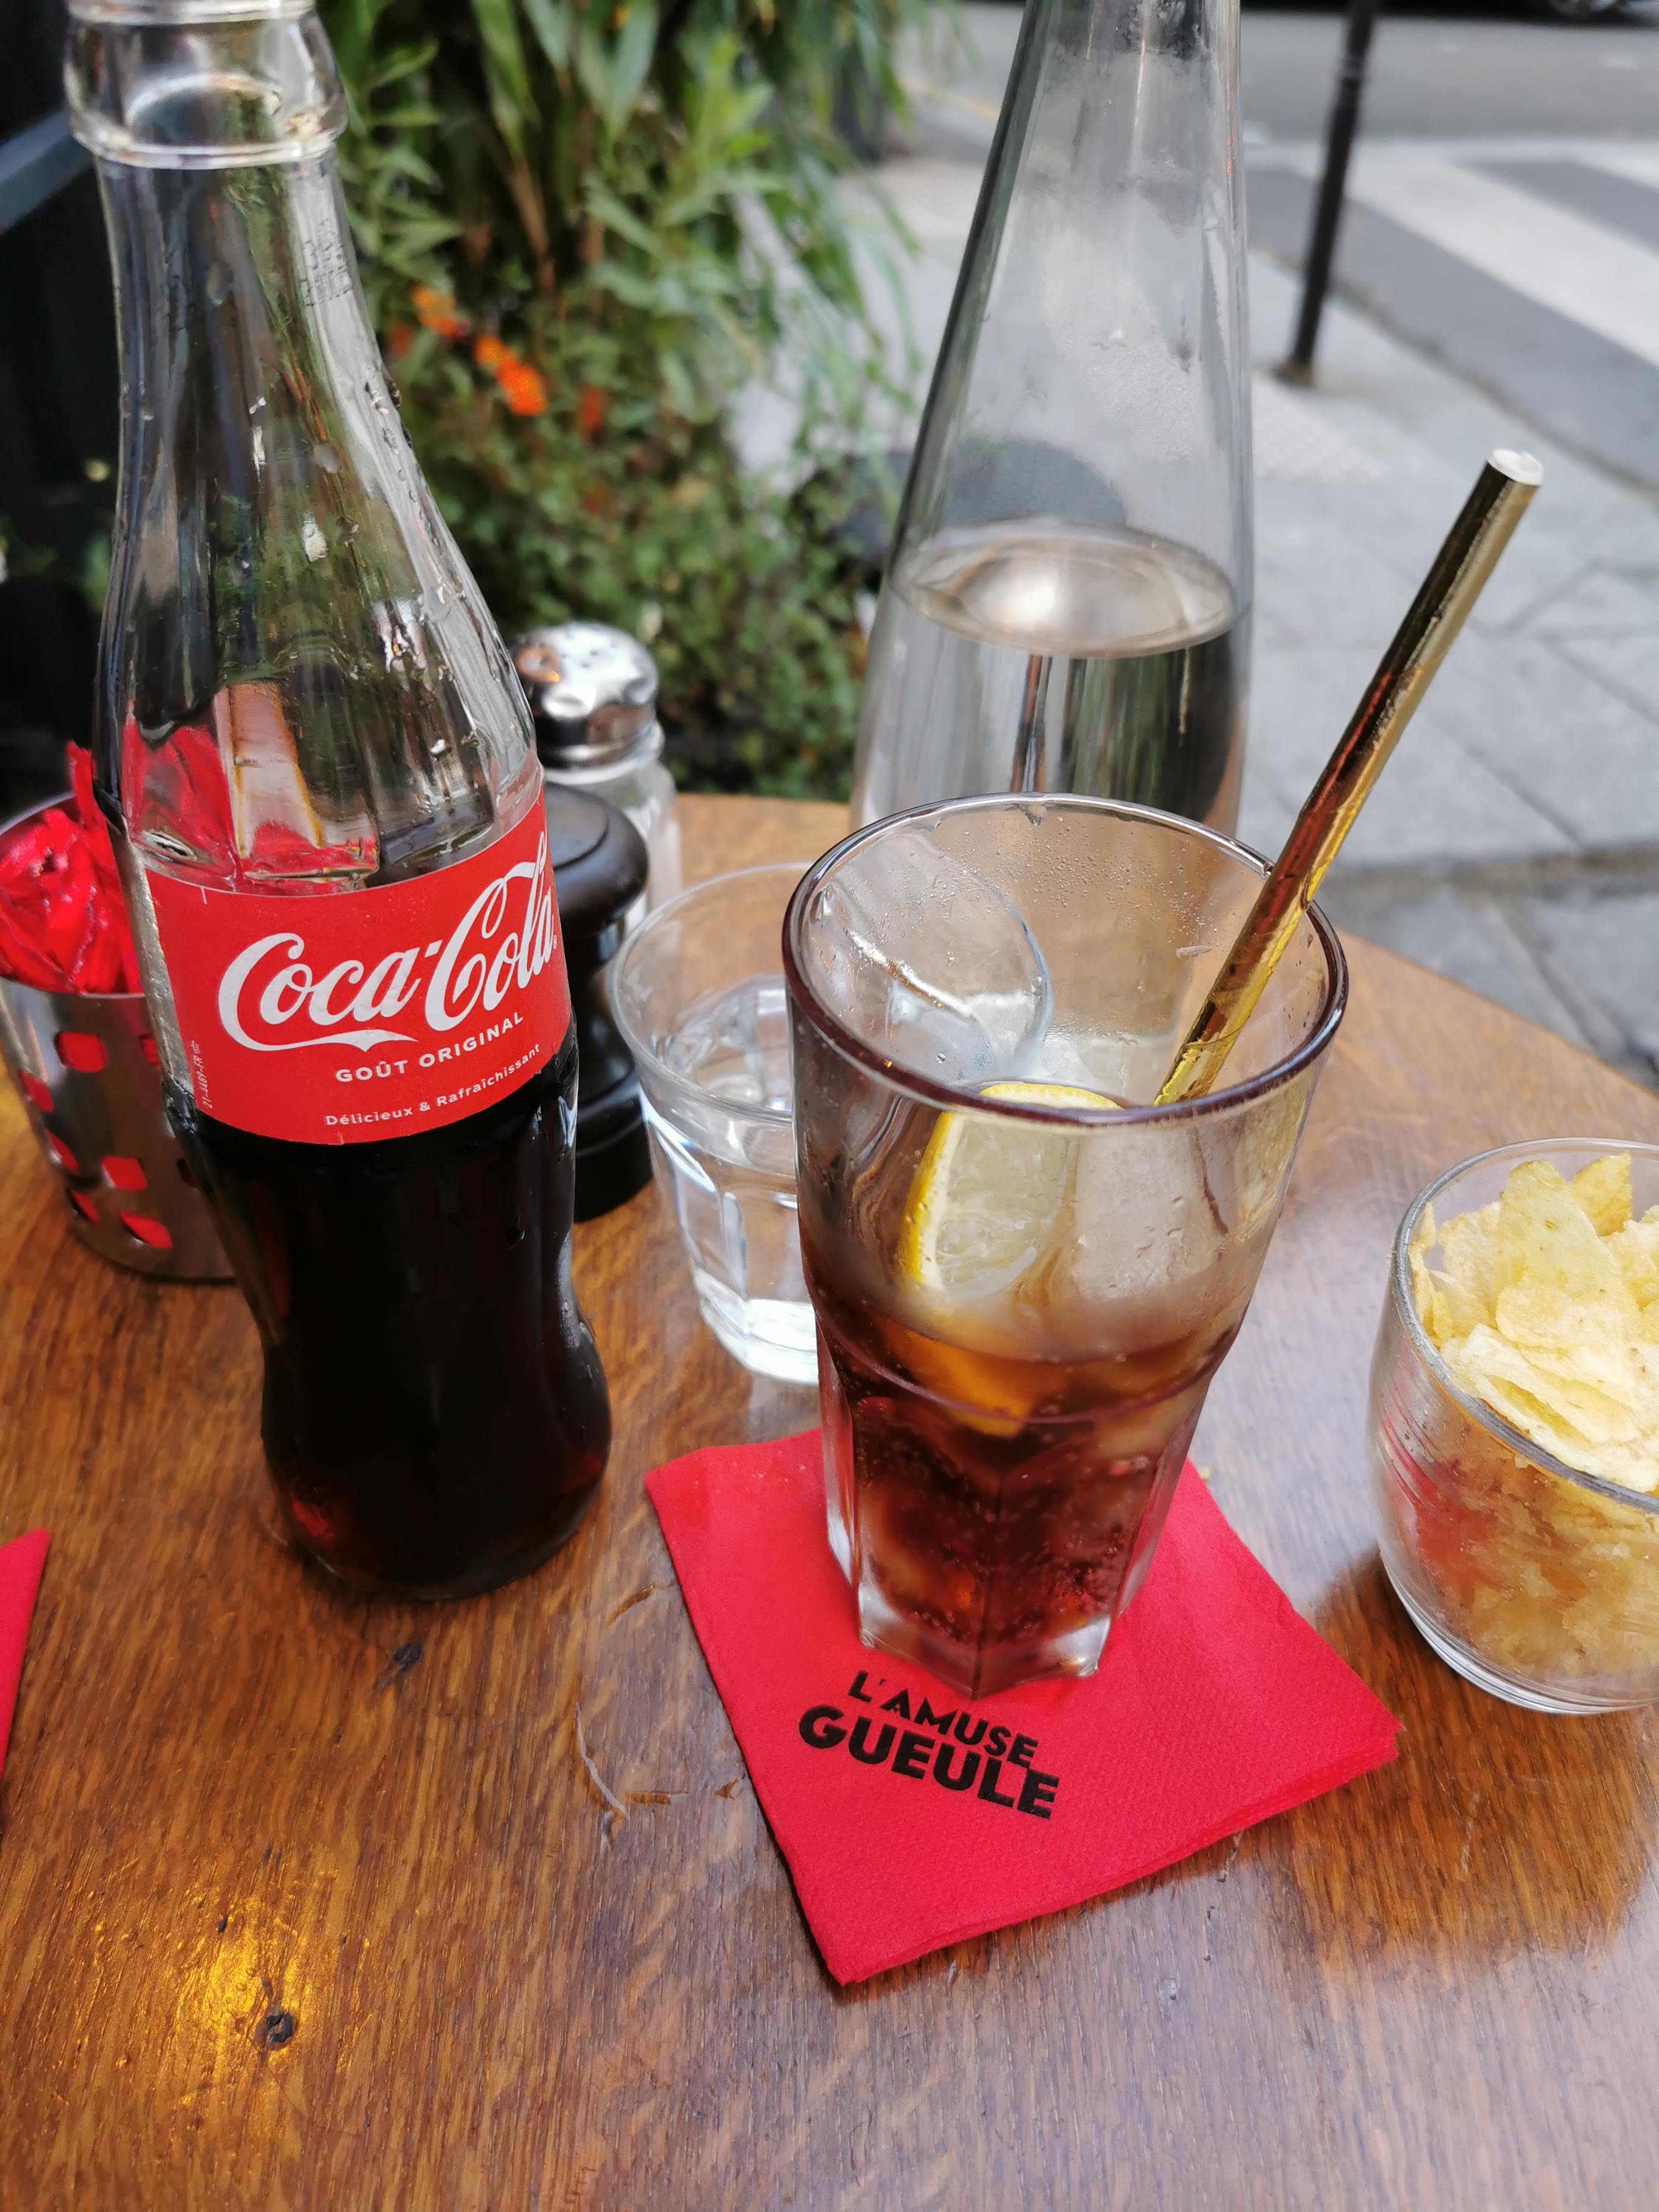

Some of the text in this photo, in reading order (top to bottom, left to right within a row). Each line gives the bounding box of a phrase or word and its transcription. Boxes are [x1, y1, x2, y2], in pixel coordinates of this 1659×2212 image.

[218, 831, 554, 1051] Coca-Cola
[325, 1044, 540, 1125] Délicieux & Rafraîchissant
[335, 1011, 524, 1082] GOÛT ORIGINAL
[799, 1704, 1060, 1820] GUEULE
[848, 1669, 1039, 1769] L'AMUSE
